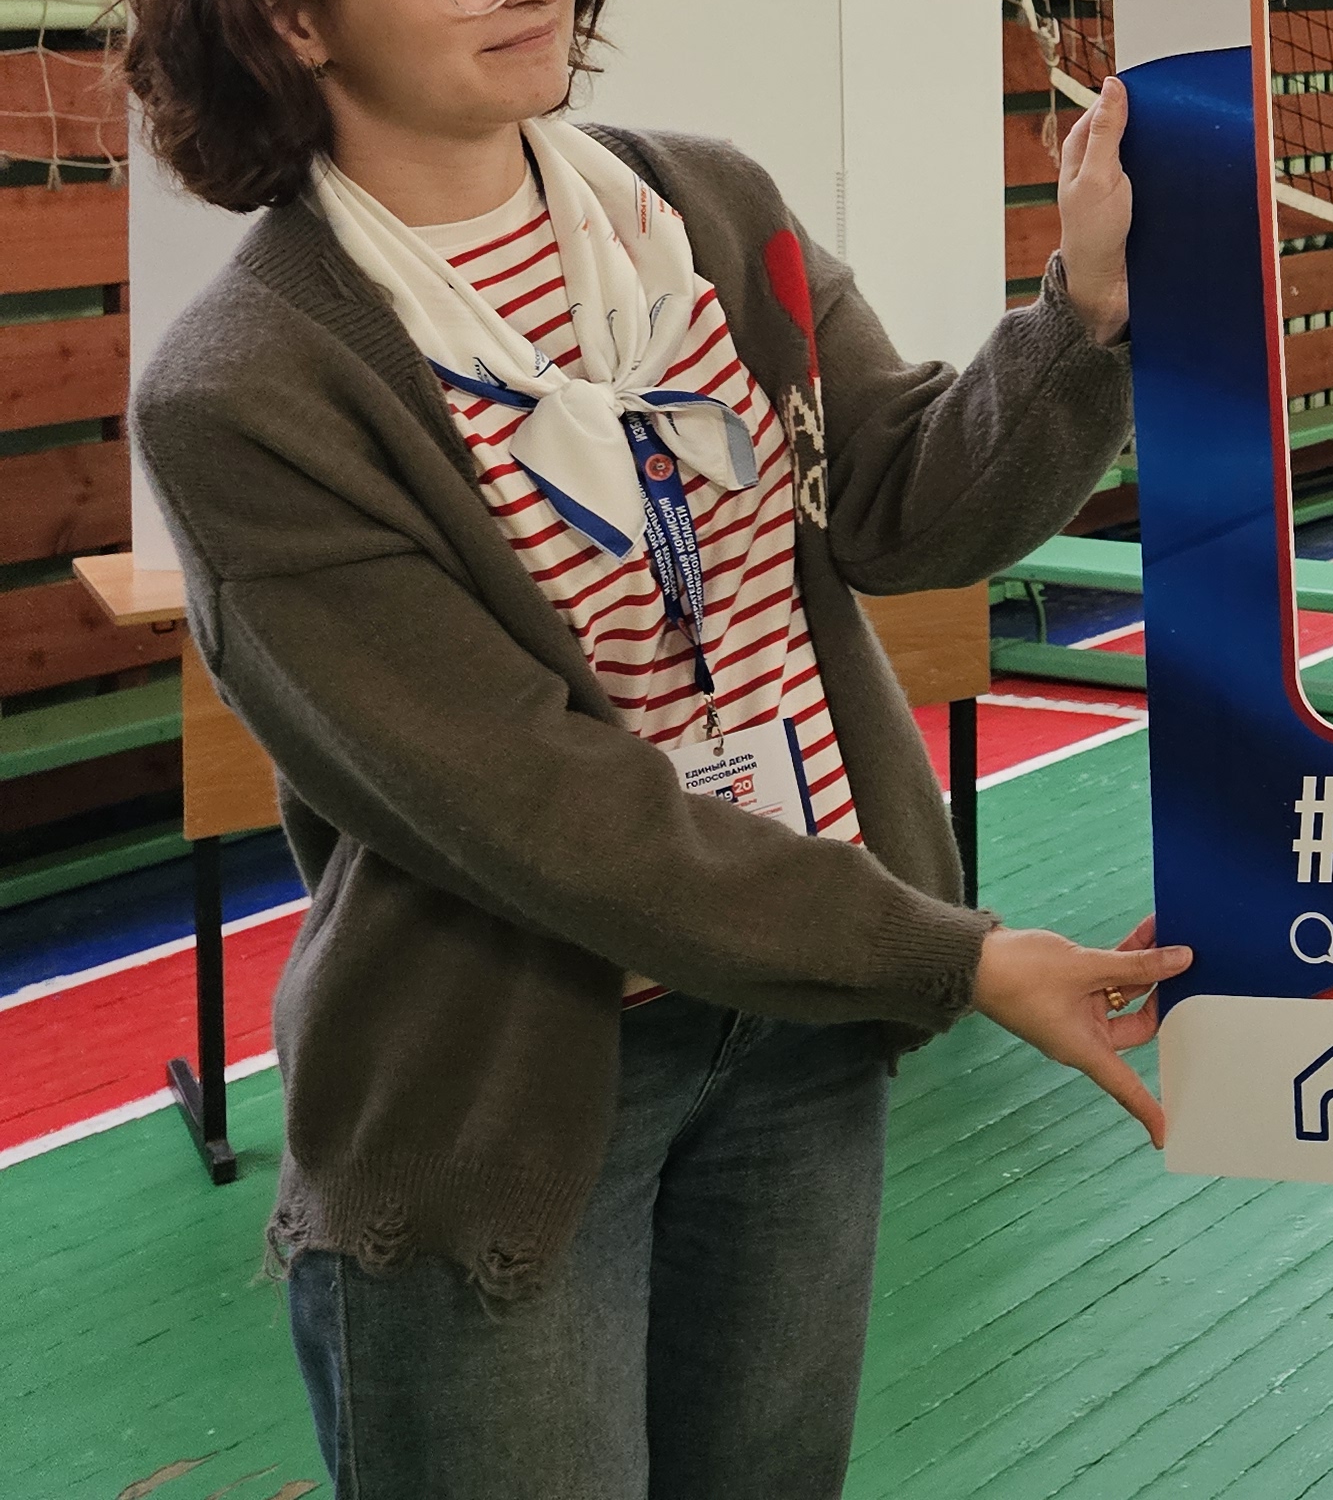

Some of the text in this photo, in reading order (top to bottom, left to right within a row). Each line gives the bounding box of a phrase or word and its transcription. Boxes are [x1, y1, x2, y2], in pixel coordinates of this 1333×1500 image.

[658, 496, 686, 554] КОМИССИЯ
[675, 504, 697, 553] ОБЛАСТИ
[655, 548, 671, 596] ОБЛАСТИ
[685, 753, 755, 780] ЕДИНЫЙ ДЕНЬ
[685, 761, 758, 790] ГОЛОСОВАНИЯ
[734, 779, 752, 793] 20
